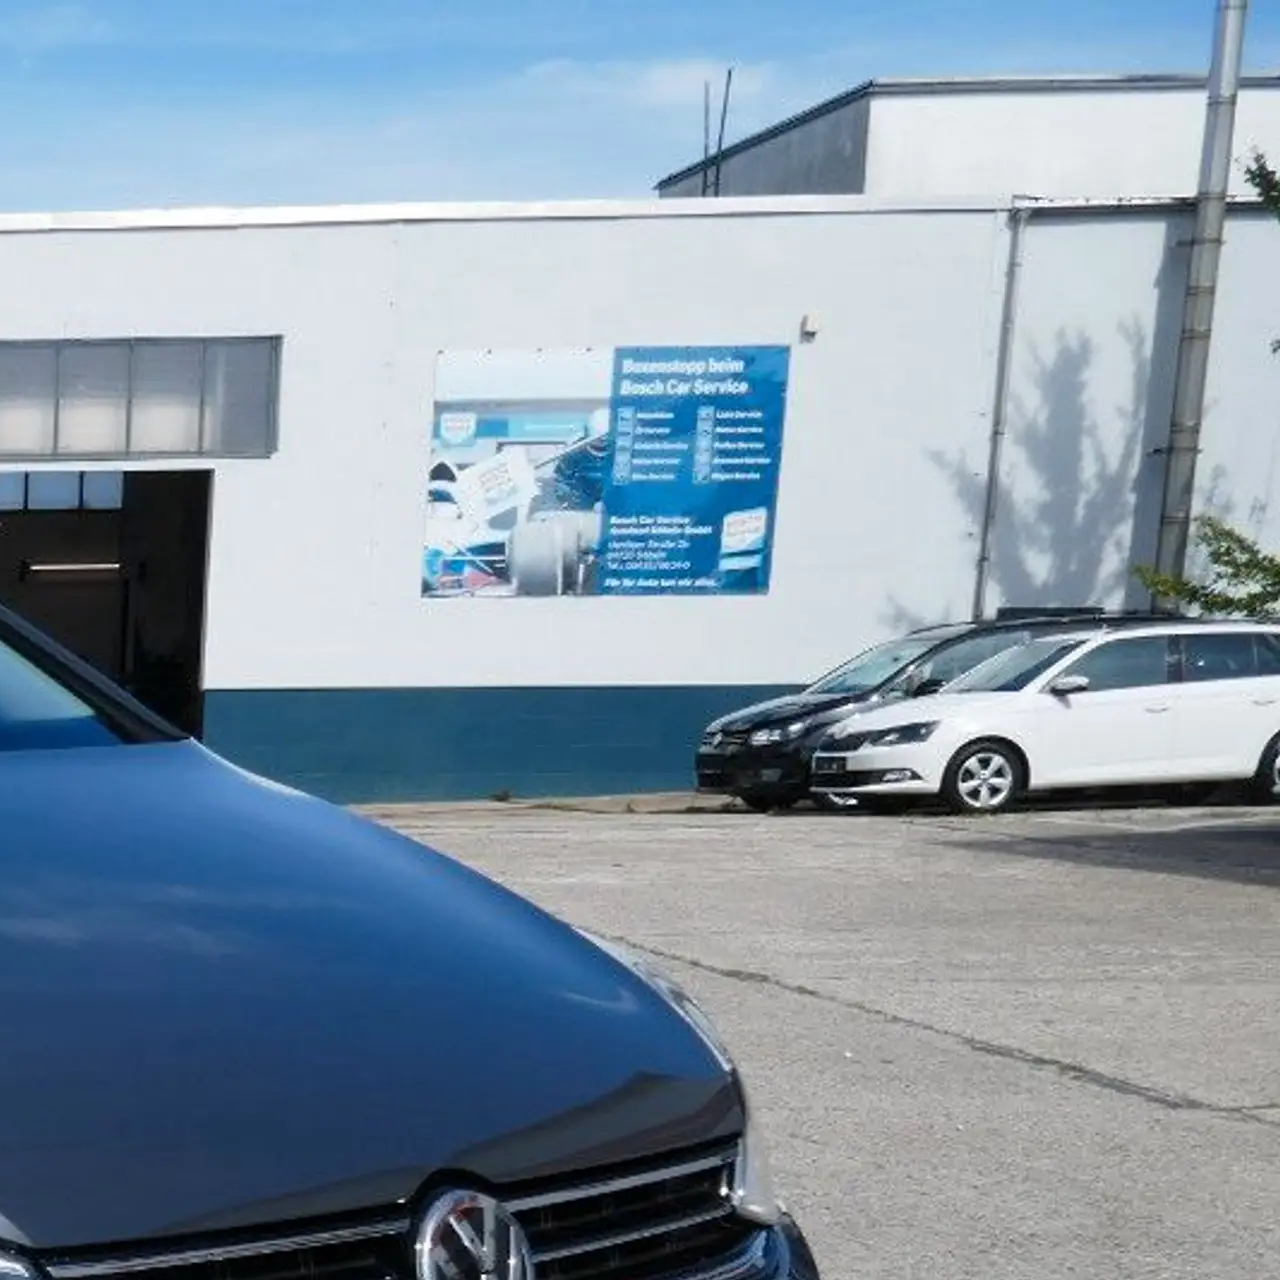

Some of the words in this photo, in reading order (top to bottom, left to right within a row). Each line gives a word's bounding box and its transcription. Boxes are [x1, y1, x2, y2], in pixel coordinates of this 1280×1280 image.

[620, 379, 664, 395] Bosch
[666, 380, 690, 395] Car
[694, 379, 748, 395] Service
